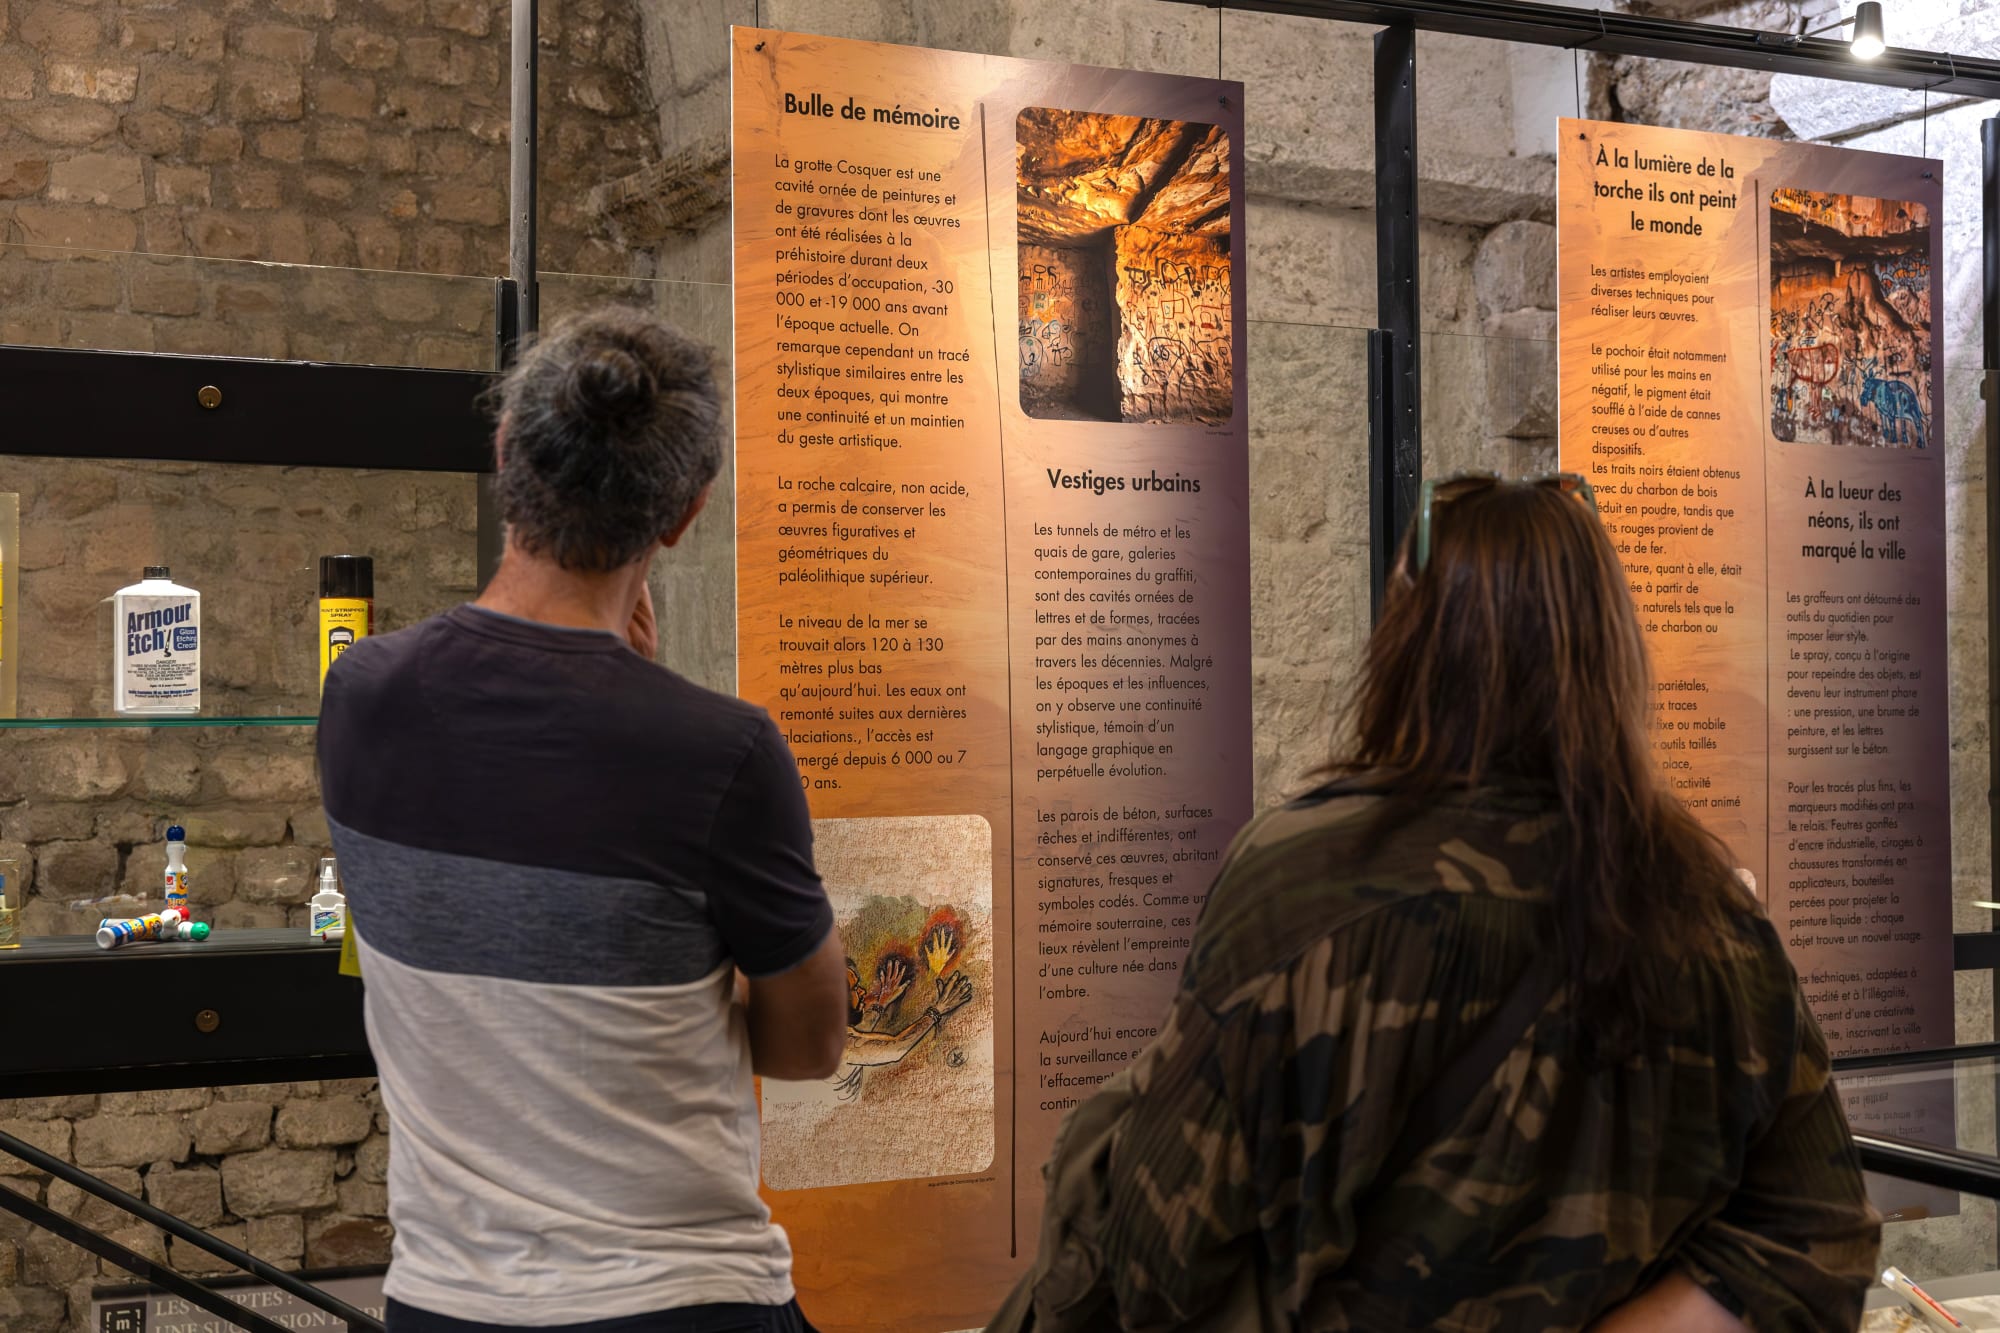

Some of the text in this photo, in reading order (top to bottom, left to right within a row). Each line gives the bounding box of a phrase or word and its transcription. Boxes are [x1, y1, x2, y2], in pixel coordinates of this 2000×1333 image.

[784, 92, 960, 130] Bulle de mémoire
[775, 153, 941, 181] La grotte Cosquer est une
[1595, 144, 1733, 178] À la lumière de la
[774, 179, 956, 205] cavité ornée de peintures et
[1593, 179, 1737, 211] torche ils ont peint
[775, 198, 960, 228] de gravures dont les œuvres
[1631, 210, 1702, 236] le monde
[775, 225, 911, 246] ont été réalisées à la
[776, 245, 928, 270] préhistoire durant deux
[1590, 282, 1714, 306] diverses techniques pour
[1591, 303, 1698, 322] réaliser leurs œuvres.
[776, 340, 969, 361] remarque cependant un tracé
[1591, 342, 1726, 362] Le pochoir était notamment
[777, 360, 963, 383] stylistique similaires entre les
[777, 409, 964, 428] une continuité et un maintien
[777, 428, 901, 451] du geste artistique.
[778, 475, 968, 497] La roche calcaire, non acide,
[1046, 468, 1200, 495] Vestiges urbains
[1804, 476, 1901, 502] À la lueur des
[1034, 522, 1190, 538] Les tunnels de métro et les
[1808, 510, 1900, 532] néons, ils ont
[778, 545, 888, 564] géométriques du
[1802, 539, 1906, 563] marqué la ville
[779, 567, 932, 587] paléolithique supérieur.
[1034, 567, 1196, 585] contemporaines du graffiti,
[127, 603, 191, 634] Armour
[779, 613, 927, 629] Le niveau de la mer se
[1035, 608, 1199, 626] lettres et de formes, tracées
[127, 628, 164, 656] Etch
[779, 636, 943, 651] trouvait alors 120 à 130
[780, 659, 882, 678] mètres plus bas
[1035, 653, 1213, 671] travers les décennies. Malgré
[1036, 674, 1209, 693] les époques et les influences,
[780, 704, 966, 720] remonté suites aux dernières
[1787, 723, 1883, 740] peinture, et les lettres
[1036, 740, 1172, 760] langage graphique en
[1037, 762, 1166, 782] perpétuelle évolution.
[1037, 847, 1218, 866] conservé ces œuvres, abritant
[155, 1300, 190, 1317] LES
